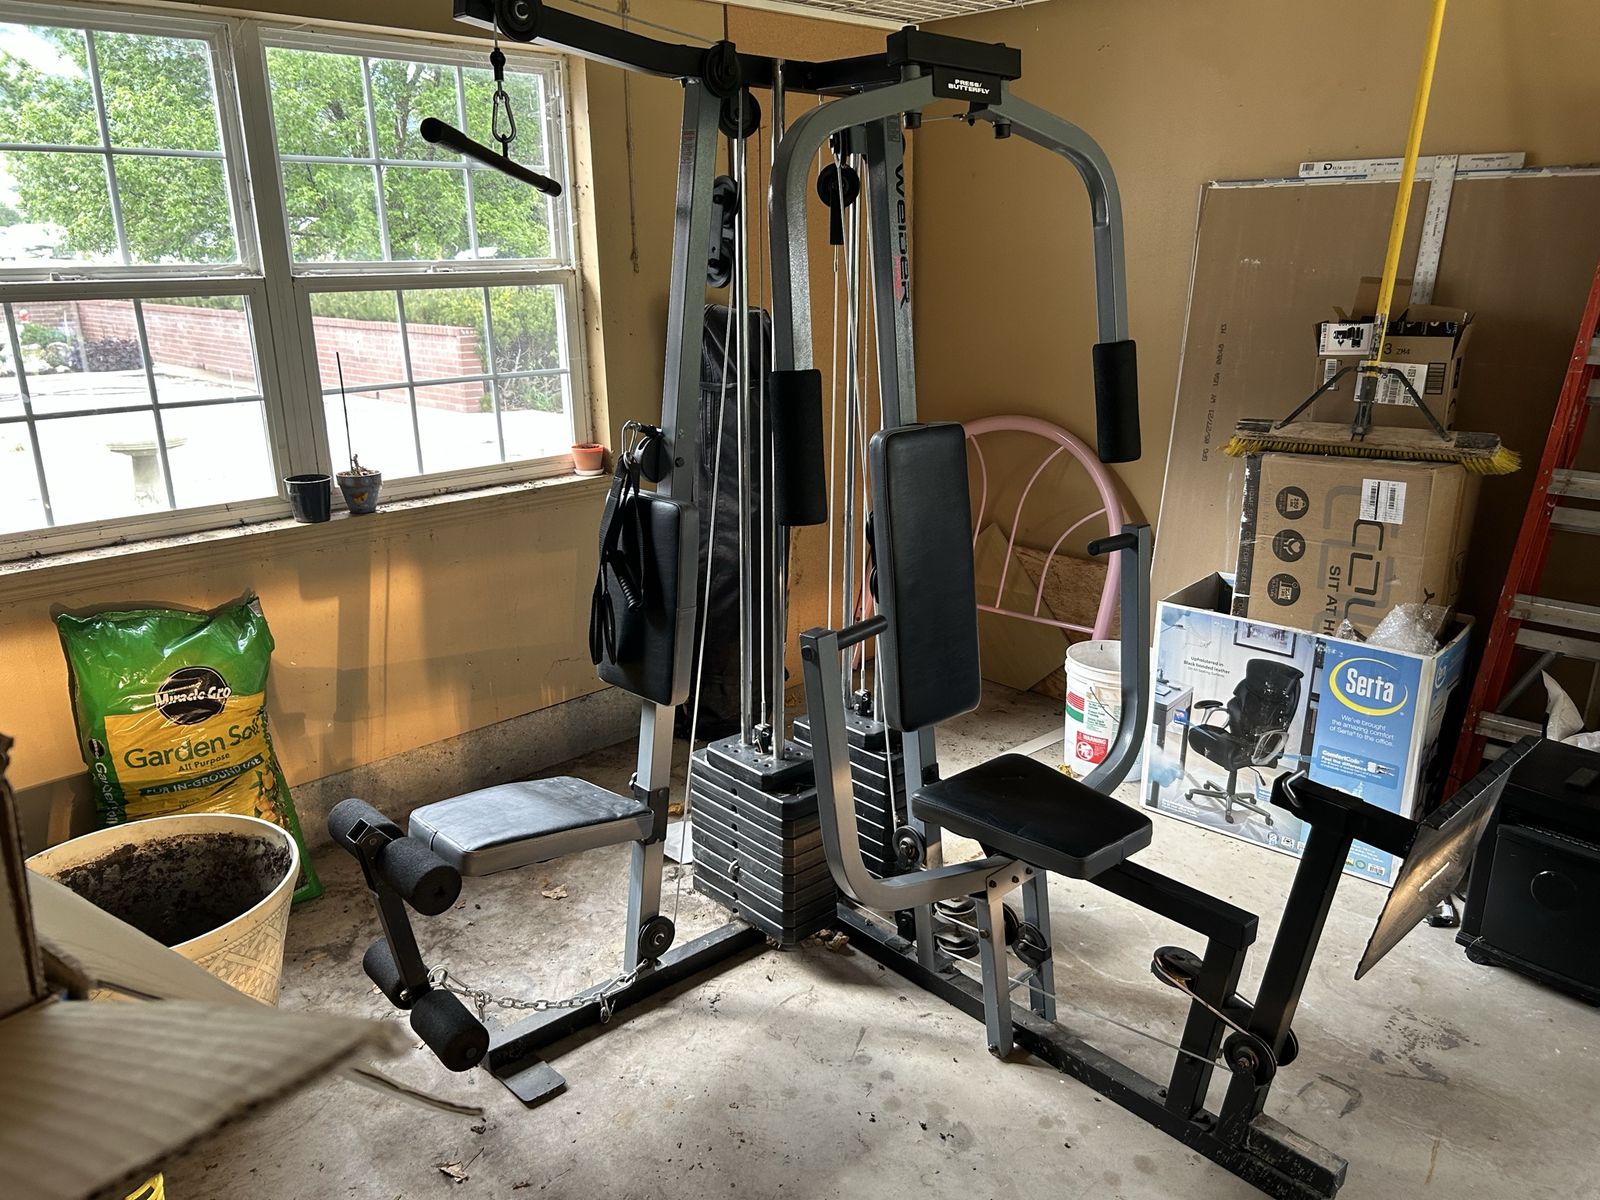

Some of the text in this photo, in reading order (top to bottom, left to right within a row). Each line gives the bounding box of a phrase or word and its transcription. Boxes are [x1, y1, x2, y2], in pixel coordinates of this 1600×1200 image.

[948, 83, 990, 94] BUTTERFLY
[954, 79, 982, 88] PRESS/
[1328, 565, 1341, 592] SIT
[1325, 594, 1339, 616] AT
[1345, 667, 1394, 703] Serta
[1332, 719, 1394, 740] the amazing comfort
[1341, 714, 1387, 732] We've brought
[124, 736, 226, 769] Garden
[228, 716, 261, 747] Soil
[1356, 731, 1364, 739] to
[1364, 733, 1375, 741] the
[178, 762, 193, 773] All
[194, 752, 231, 769] Purpose
[173, 763, 242, 792] IN-GROUND
